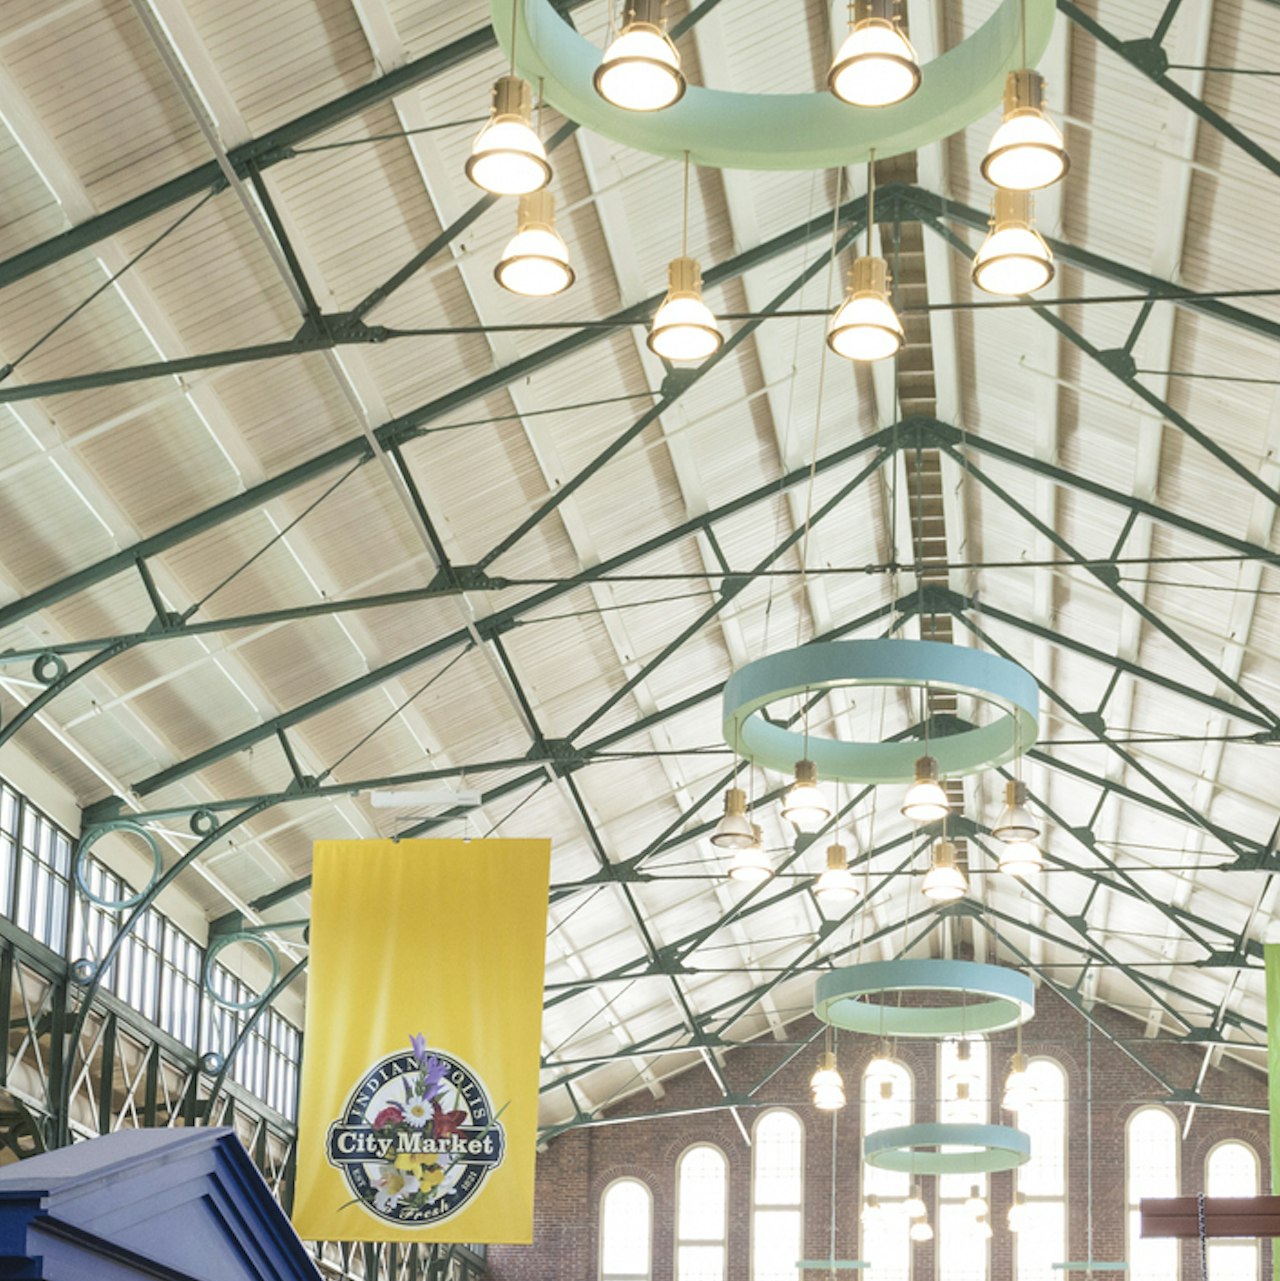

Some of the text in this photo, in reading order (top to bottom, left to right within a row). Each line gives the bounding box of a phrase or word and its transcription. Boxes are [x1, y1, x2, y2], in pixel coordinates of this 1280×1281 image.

[350, 1056, 487, 1119] INDIANOLIS
[337, 1130, 494, 1158] City Market
